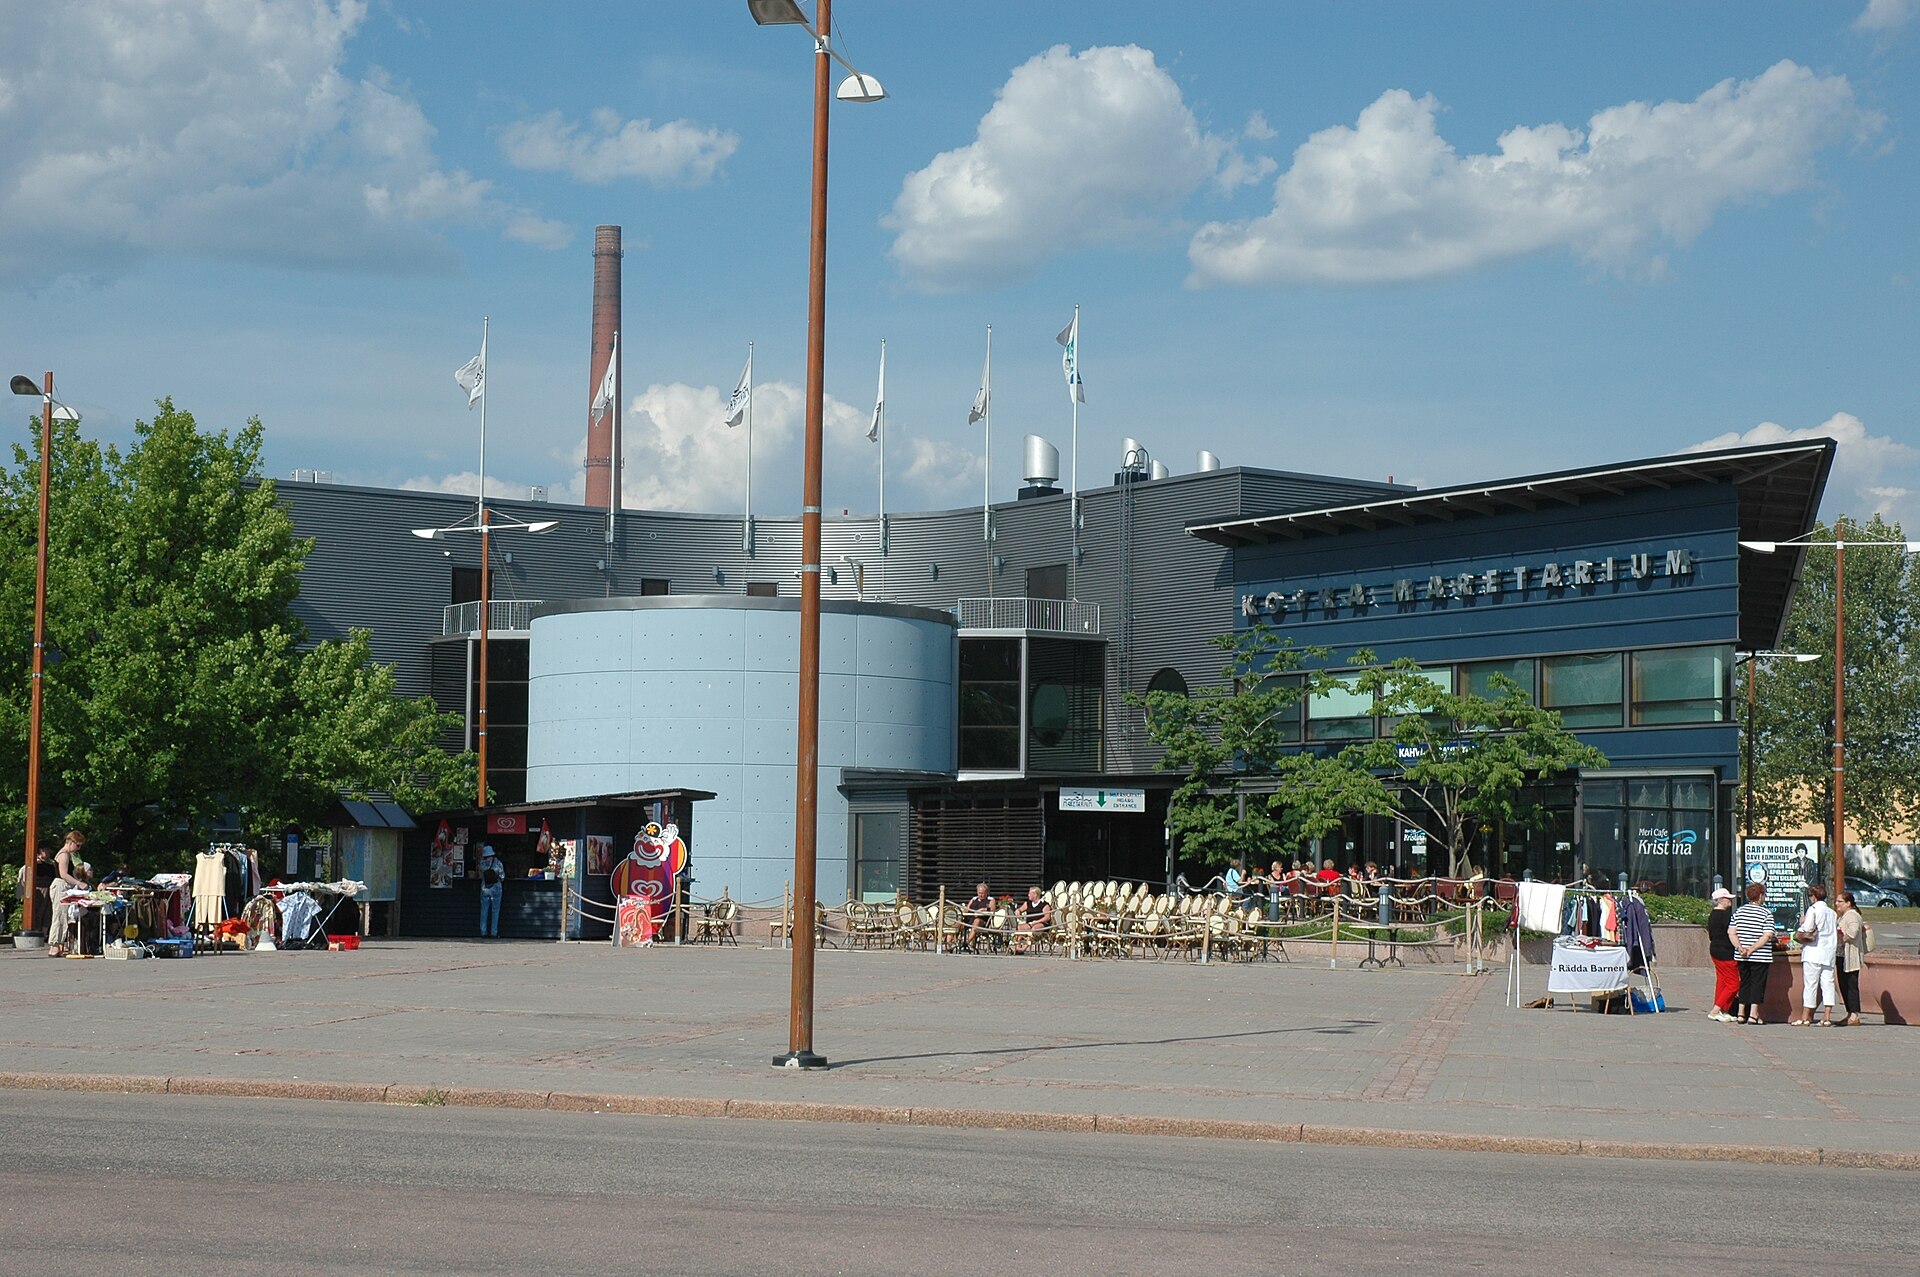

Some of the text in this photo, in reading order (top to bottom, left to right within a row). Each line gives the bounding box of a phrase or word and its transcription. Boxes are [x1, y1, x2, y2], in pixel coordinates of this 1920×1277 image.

[1393, 549, 1693, 603] MARETARIUM
[1638, 828, 1668, 838] Meri Cafe
[1638, 839, 1692, 855] Kristina
[1746, 845, 1794, 854] GARY MOORE
[1558, 964, 1588, 973] Rädda
[1590, 964, 1625, 973] Barnen
